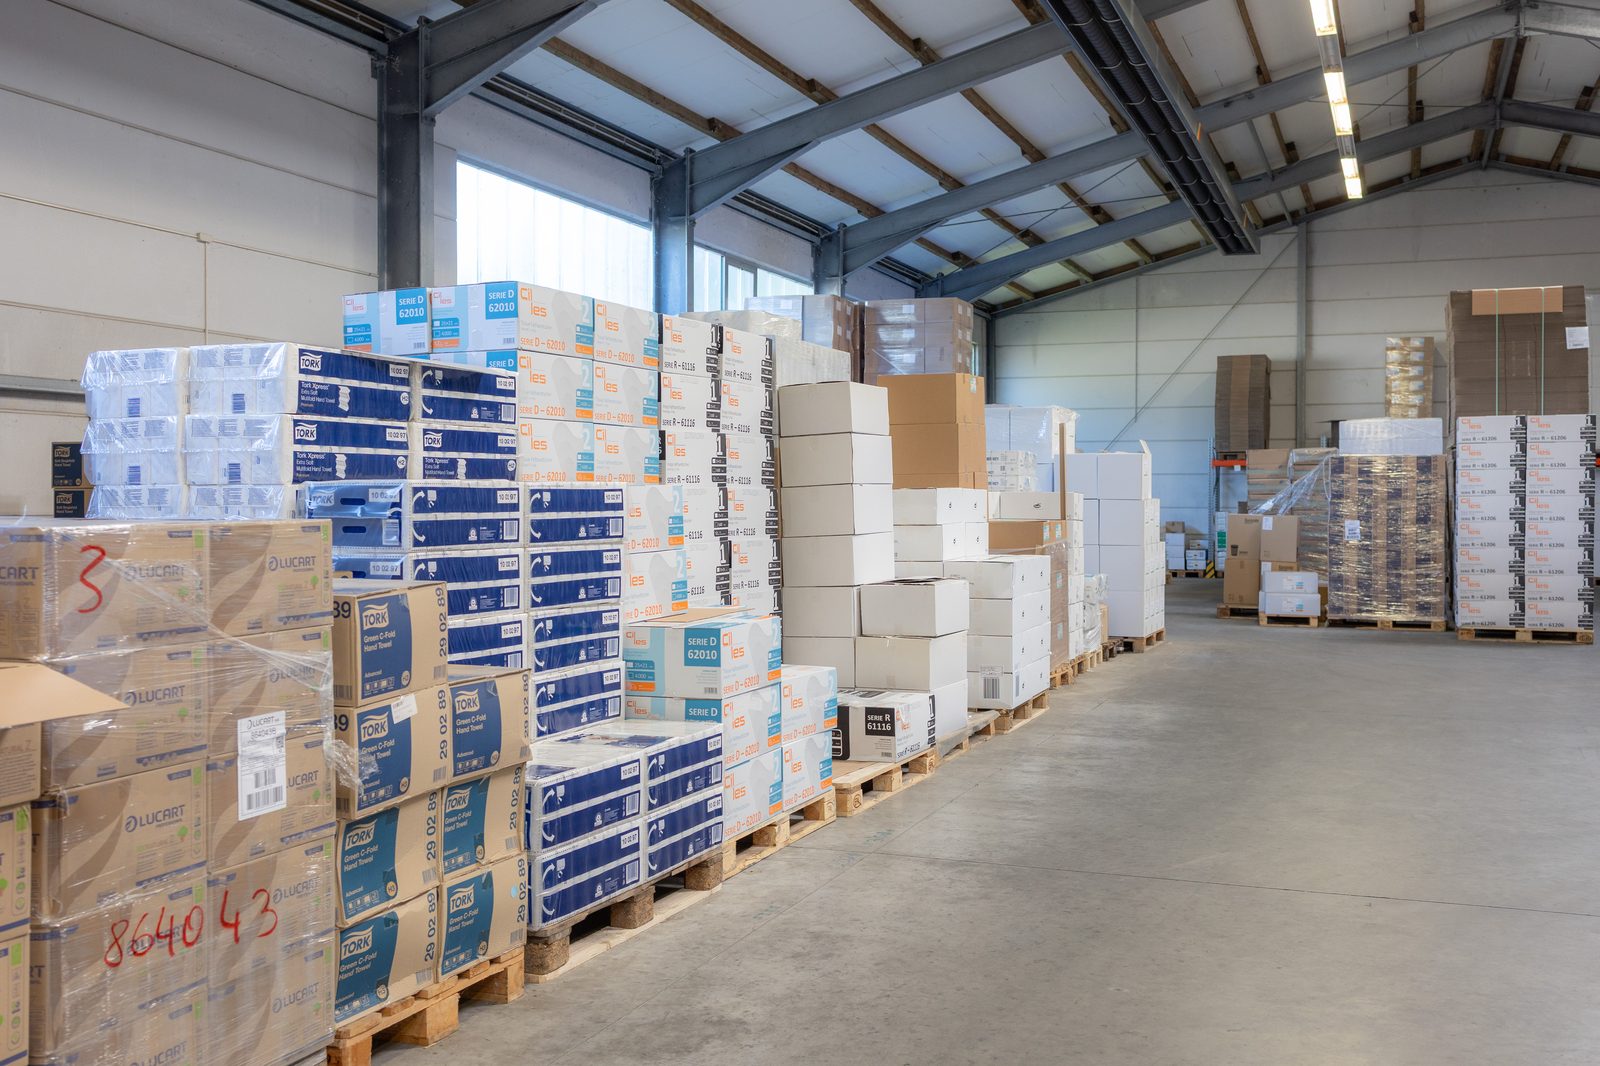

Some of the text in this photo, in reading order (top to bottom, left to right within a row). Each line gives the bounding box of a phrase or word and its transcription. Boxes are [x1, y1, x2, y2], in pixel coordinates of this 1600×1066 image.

[399, 296, 424, 306] SERIE D
[488, 290, 515, 300] SERIE D
[400, 308, 424, 318] 62010
[488, 302, 514, 312] 62010
[534, 338, 540, 346] D
[546, 339, 566, 350] 62010
[618, 350, 634, 362] 62010
[302, 358, 320, 368] TORK
[489, 358, 514, 368] SERIE D
[546, 406, 566, 416] 62010
[681, 418, 695, 427] 61116
[297, 428, 315, 438] TORK
[425, 436, 441, 445] TORK
[686, 475, 700, 484] 61116
[279, 556, 316, 568] LUCART
[0, 567, 38, 579] CART
[138, 565, 186, 578] LUCART
[364, 613, 388, 627] TORK
[436, 588, 447, 657] 29 02 89
[364, 631, 396, 642] Green C-Fold
[710, 636, 716, 646] D
[364, 644, 377, 652] Hand
[688, 650, 717, 660] 62010
[735, 680, 740, 691] D
[744, 675, 760, 688] 62010
[138, 685, 185, 702] LUCART
[457, 698, 478, 711] TORK
[522, 674, 530, 738] 29 02 89
[688, 706, 718, 716] SERIE D
[456, 714, 486, 726] Green C-Fold
[884, 714, 890, 722] R
[361, 724, 387, 738] TORK
[438, 690, 448, 760] 29 02 89
[470, 724, 484, 732] Towel
[802, 724, 816, 736] 62010
[867, 722, 892, 730] 61116
[379, 739, 395, 748] C-Fold
[286, 770, 318, 788] UCART
[510, 766, 521, 830] 29 02 89
[802, 787, 814, 800] 62010
[446, 794, 468, 810] TORK
[139, 805, 185, 826] LUCART
[444, 810, 472, 824] Green C-Fold
[746, 811, 762, 827] 62010
[426, 792, 438, 860] 29 02 89
[346, 830, 372, 846] TORK
[344, 845, 378, 862] Green C-Fold
[344, 856, 374, 871] Hand Towel
[283, 877, 320, 898] LUCART
[517, 858, 526, 922] 29 02 89
[451, 892, 472, 906] TORK
[450, 908, 478, 924] Green C-Fold
[425, 892, 436, 962] 29 02 89
[449, 918, 474, 933] Hand Towel
[342, 936, 370, 956] TORK
[340, 952, 377, 972] Green C-Fold
[339, 963, 372, 980] Hand Towel
[284, 982, 319, 1008] LUCART
